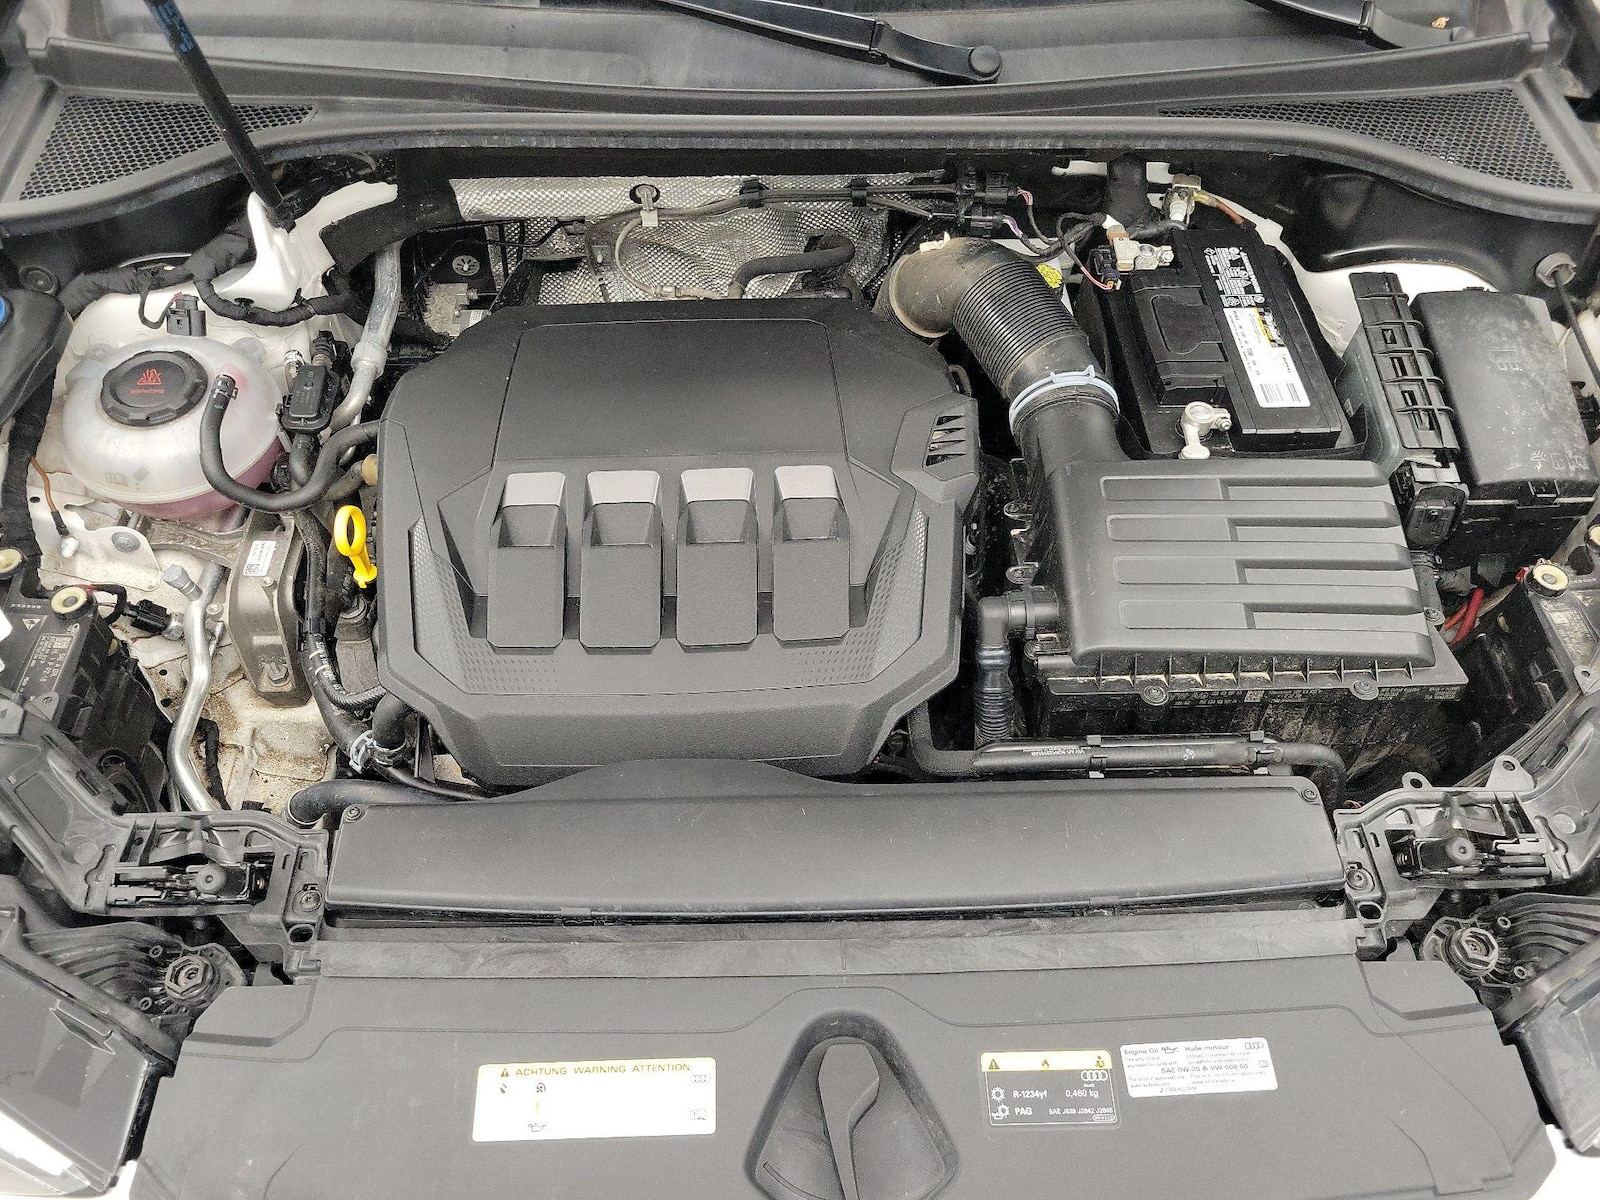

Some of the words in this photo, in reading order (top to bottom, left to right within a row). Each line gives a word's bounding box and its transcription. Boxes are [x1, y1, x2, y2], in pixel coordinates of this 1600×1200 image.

[1184, 1044, 1203, 1052] Huile
[515, 1067, 568, 1077] ACHTUNG
[573, 1065, 626, 1075] WARNING
[631, 1063, 691, 1073] ATTENTION
[1012, 1089, 1048, 1100] R-1234yf
[1065, 1088, 1088, 1099] 0,460
[1088, 1088, 1100, 1099] kg
[1013, 1106, 1033, 1116] PAG
[1048, 1107, 1061, 1115] SAE
